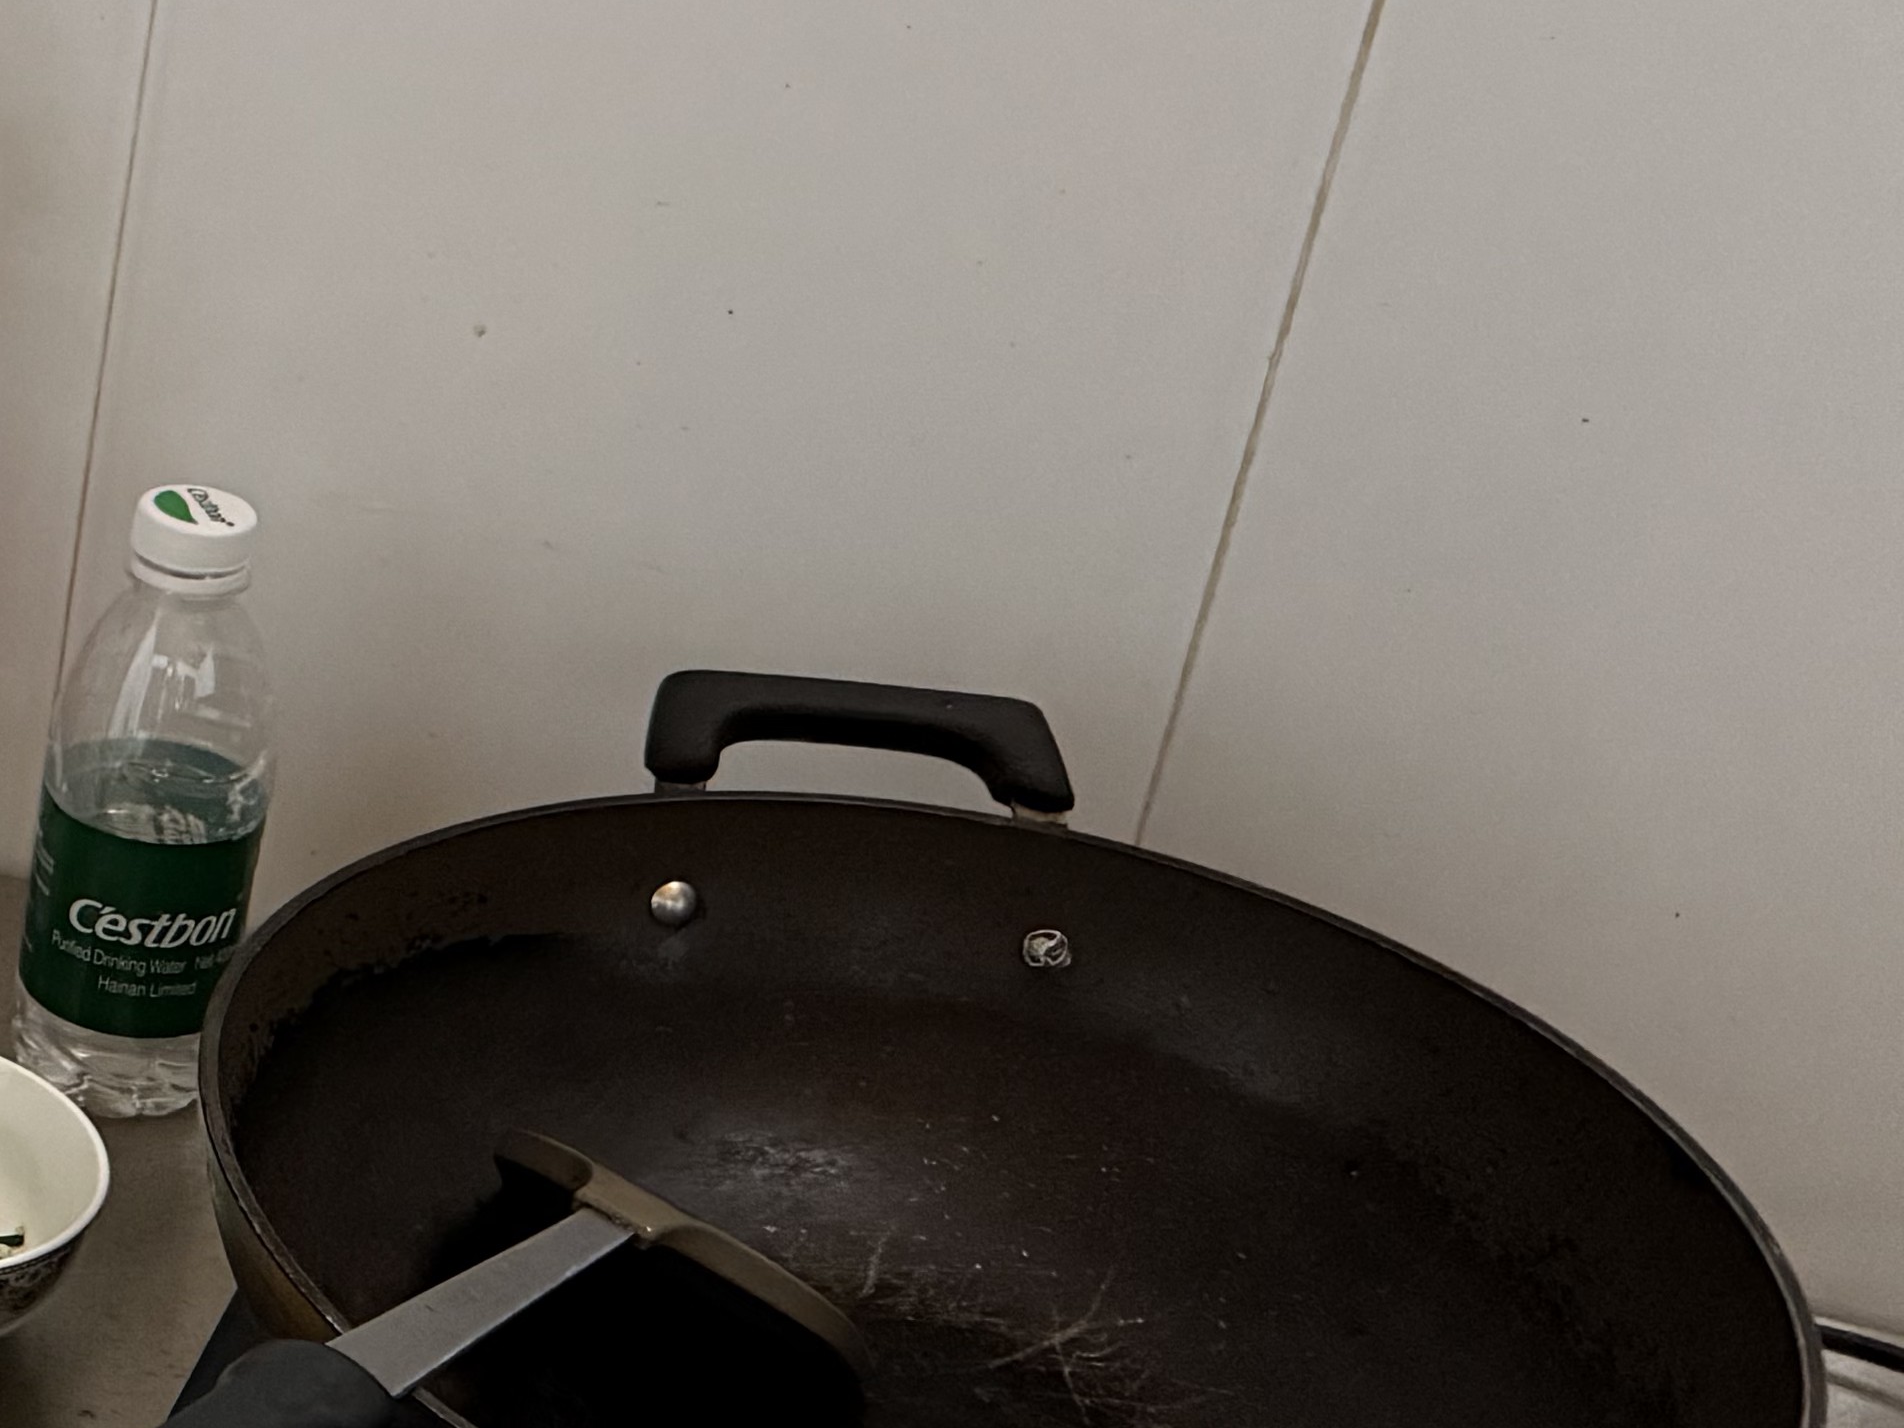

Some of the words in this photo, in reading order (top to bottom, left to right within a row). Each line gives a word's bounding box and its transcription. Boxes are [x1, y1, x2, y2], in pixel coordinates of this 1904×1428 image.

[51, 928, 92, 962] Purified
[93, 948, 146, 978] Drinking
[149, 958, 188, 975] Water
[97, 974, 146, 997] Hainan
[149, 980, 198, 998] Limited
